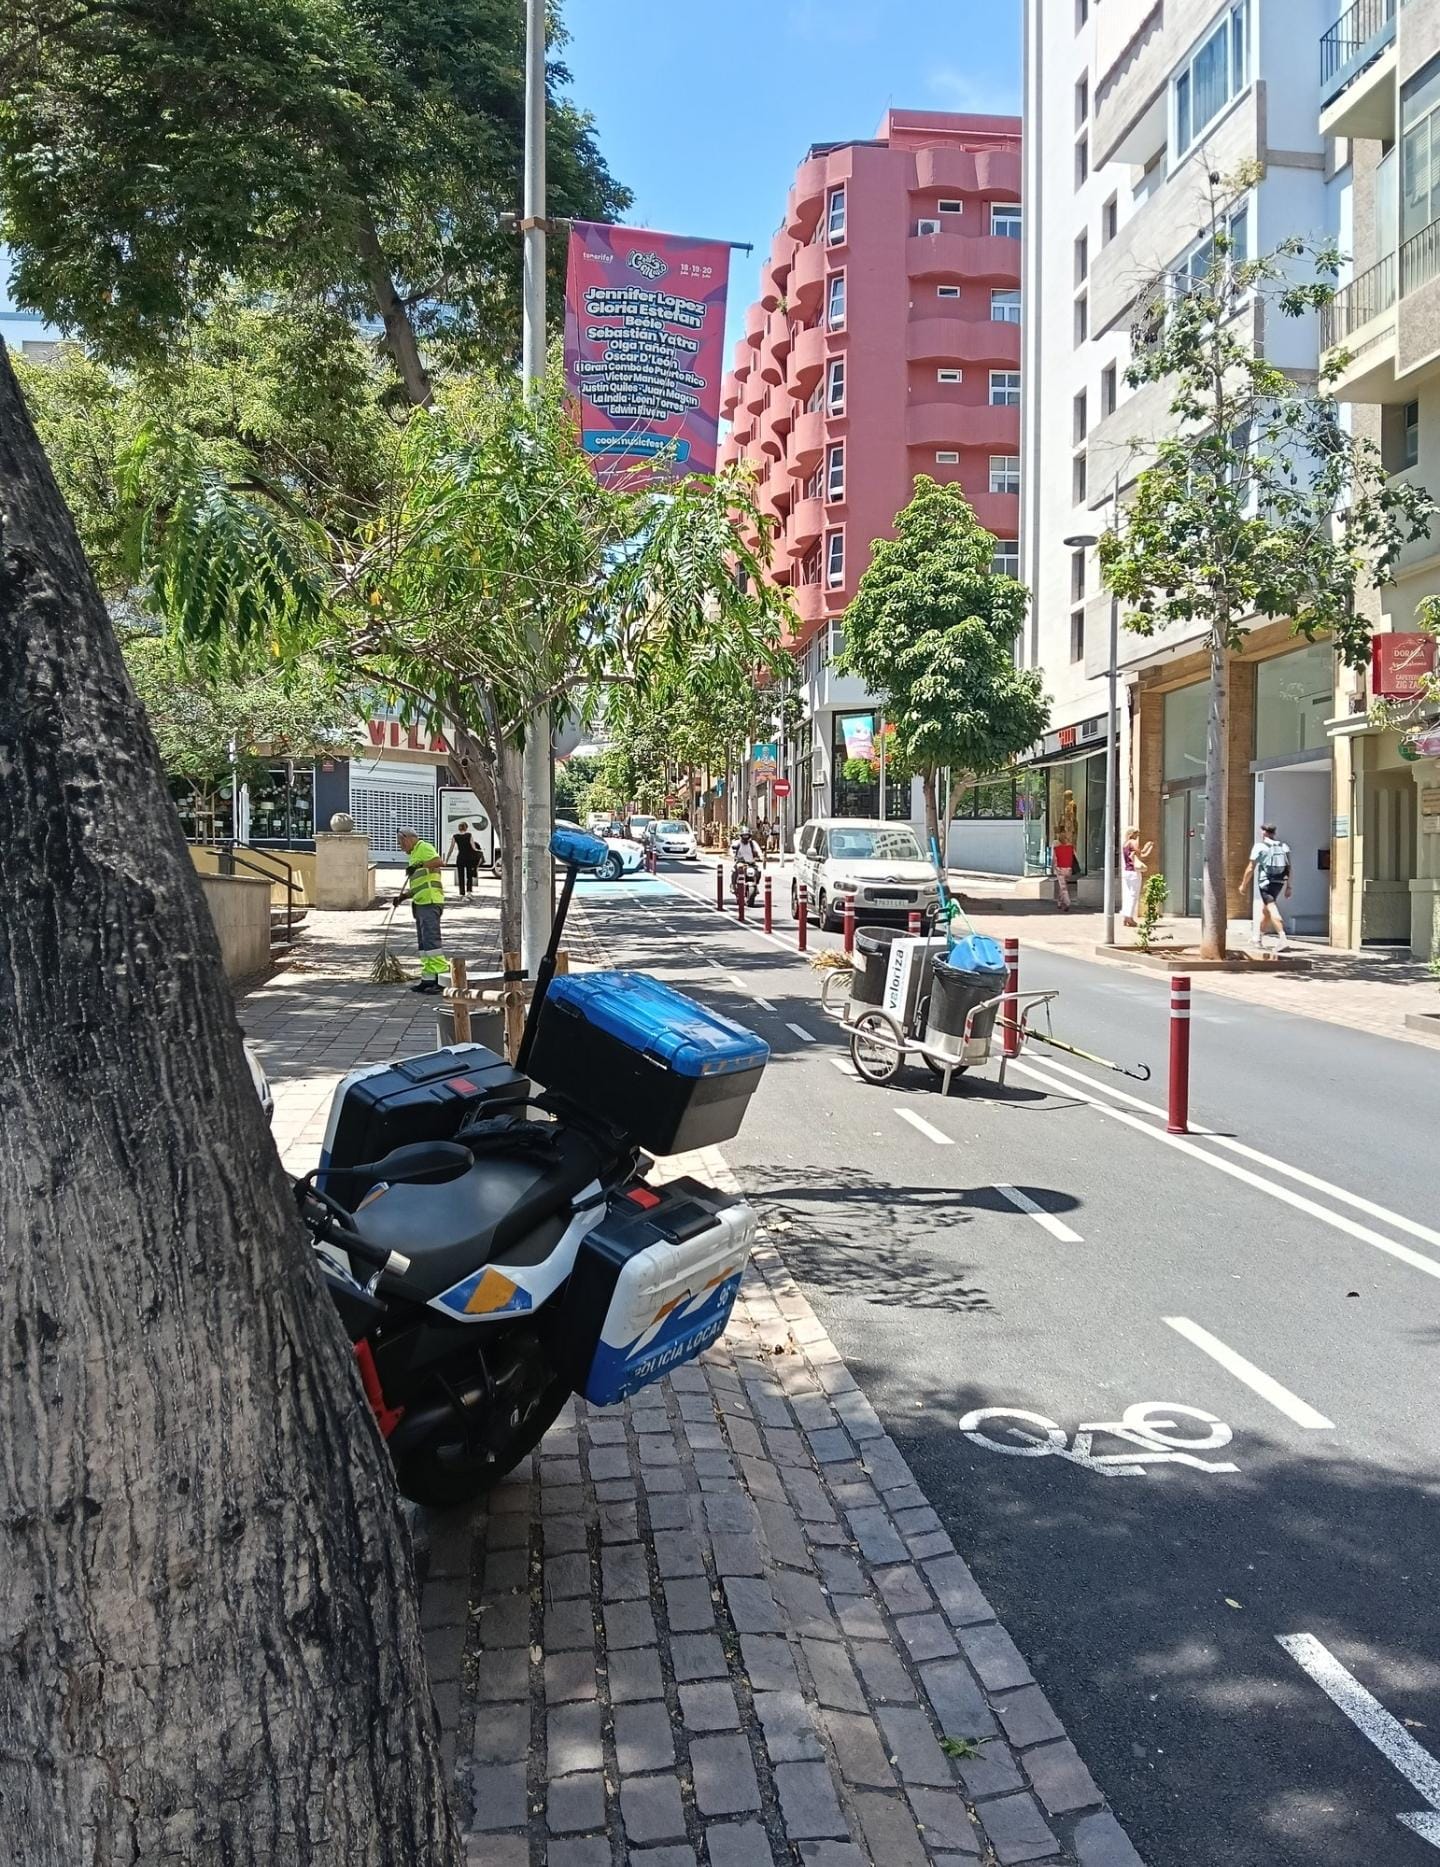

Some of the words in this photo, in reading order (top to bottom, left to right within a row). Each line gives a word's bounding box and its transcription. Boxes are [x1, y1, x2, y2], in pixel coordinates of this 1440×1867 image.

[585, 287, 656, 303] Jennifer
[658, 292, 705, 314] Lopez
[586, 301, 638, 314] Gloria
[640, 304, 701, 327] Estefan
[588, 327, 659, 340] Sebastián
[660, 332, 698, 351] Yatra
[610, 340, 637, 352] Olga
[639, 342, 675, 356] Tañón
[604, 352, 639, 361] Oscar
[640, 353, 679, 369] D'León
[585, 363, 608, 371] Gran
[608, 362, 642, 371] Combo
[642, 364, 655, 374] de
[685, 373, 705, 387] Rico
[582, 382, 610, 393] Justin
[609, 382, 638, 393] Quiles
[642, 385, 666, 397] Juan
[593, 394, 605, 402] La
[604, 393, 628, 402] India
[631, 394, 656, 406] Leoni
[656, 396, 685, 411] Torres
[610, 403, 637, 415] Edwin
[637, 404, 667, 419] Rivera
[1395, 680, 1407, 689] ZIG
[1408, 681, 1421, 689] ZA
[889, 949, 905, 1009] valoriza
[686, 1320, 722, 1352] LOCAL
